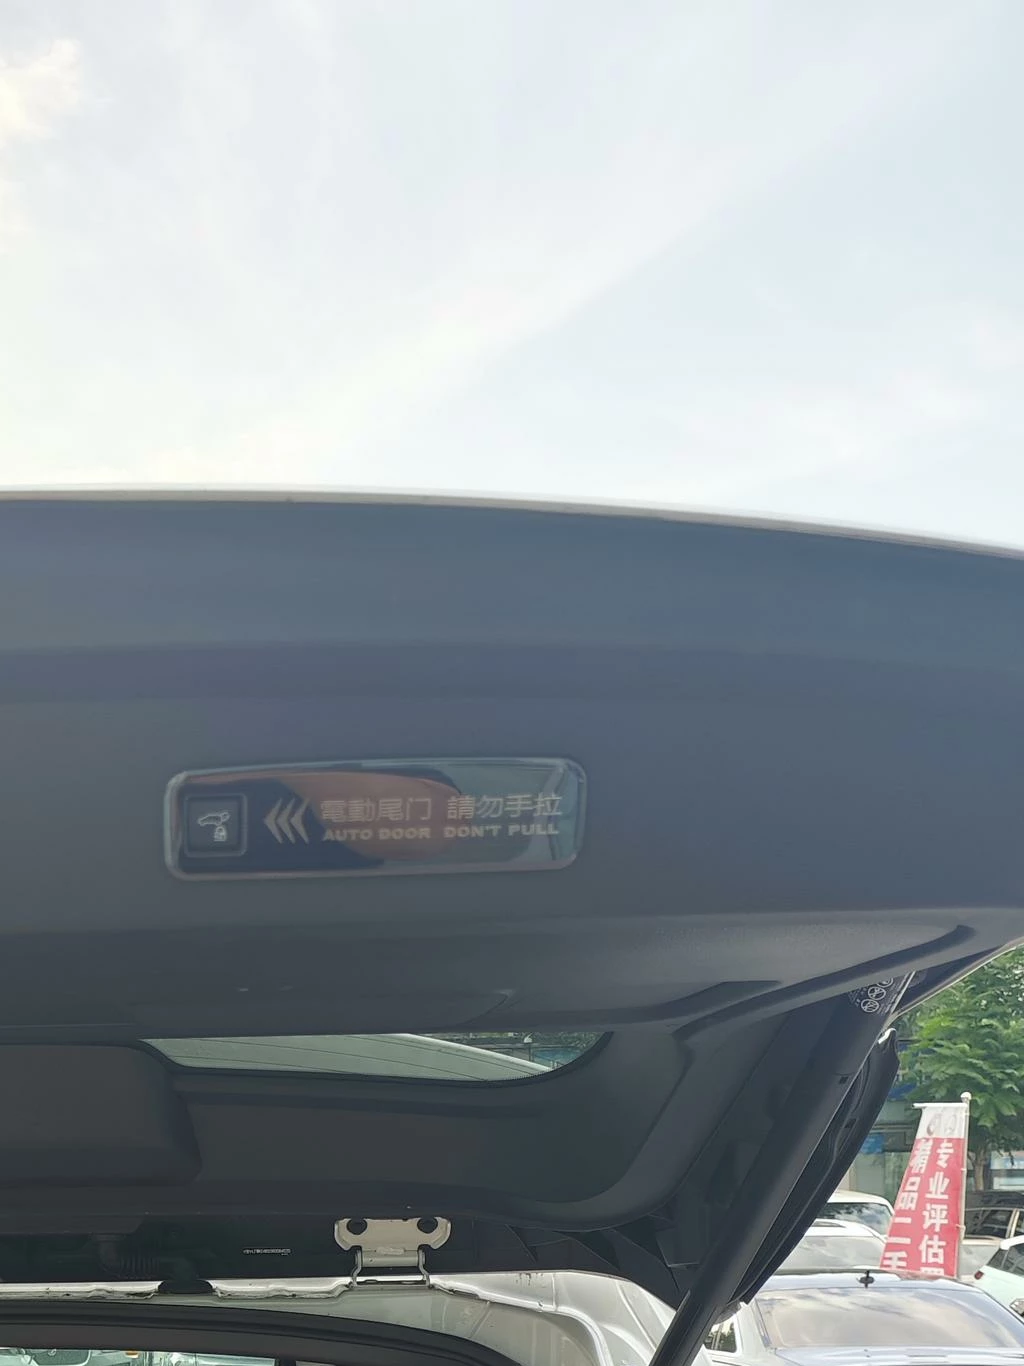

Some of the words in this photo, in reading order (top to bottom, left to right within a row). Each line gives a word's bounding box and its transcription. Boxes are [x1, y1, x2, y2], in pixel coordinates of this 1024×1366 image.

[323, 828, 373, 841] AUTO
[379, 827, 431, 840] DOOR
[444, 825, 500, 838] DON'T
[508, 823, 559, 836] PULL
